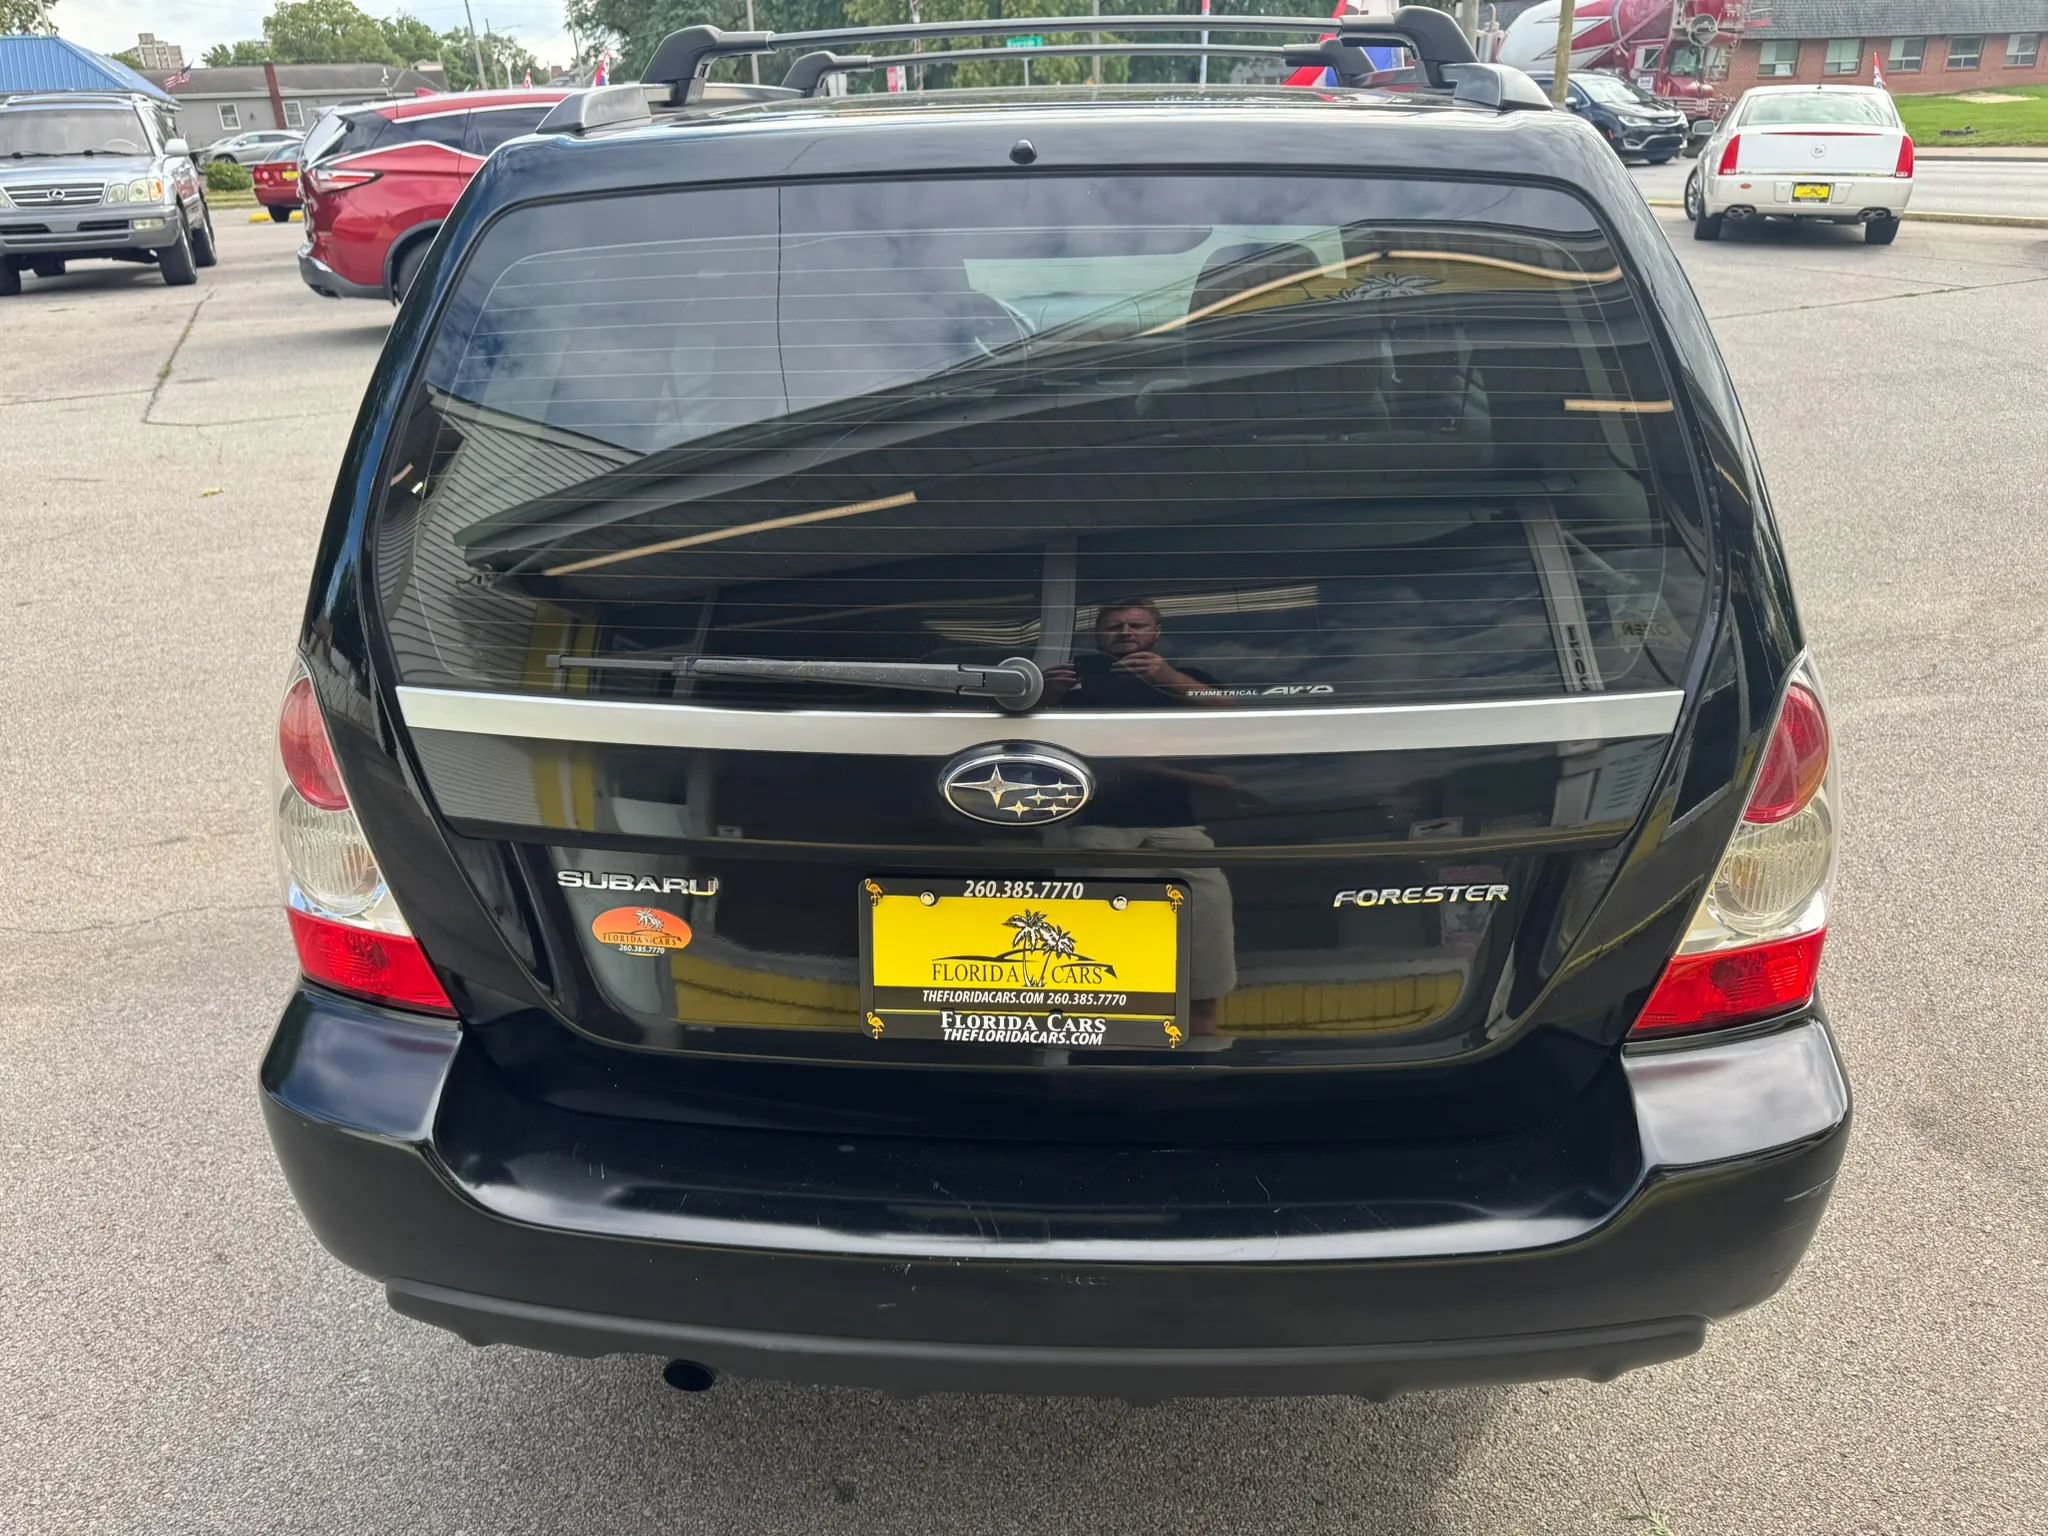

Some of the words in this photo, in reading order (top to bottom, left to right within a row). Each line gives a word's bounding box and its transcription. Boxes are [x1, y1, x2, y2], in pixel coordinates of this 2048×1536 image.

[1262, 685, 1335, 695] AWD
[557, 870, 719, 896] SUBARU
[963, 880, 1084, 899] 260.385.7770
[1333, 884, 1510, 908] FORESTER
[604, 932, 643, 944] FLORIDA
[652, 936, 678, 947] CARS
[618, 944, 665, 954] 260.385.7770
[931, 963, 1019, 983] FLORIDA
[1051, 966, 1103, 985] CARS
[922, 990, 1044, 1005] THEFLORIDACARS.COM
[1047, 992, 1127, 1007] 260.385.7770
[943, 1028, 1104, 1046] THEFLORIDACARS.COM
